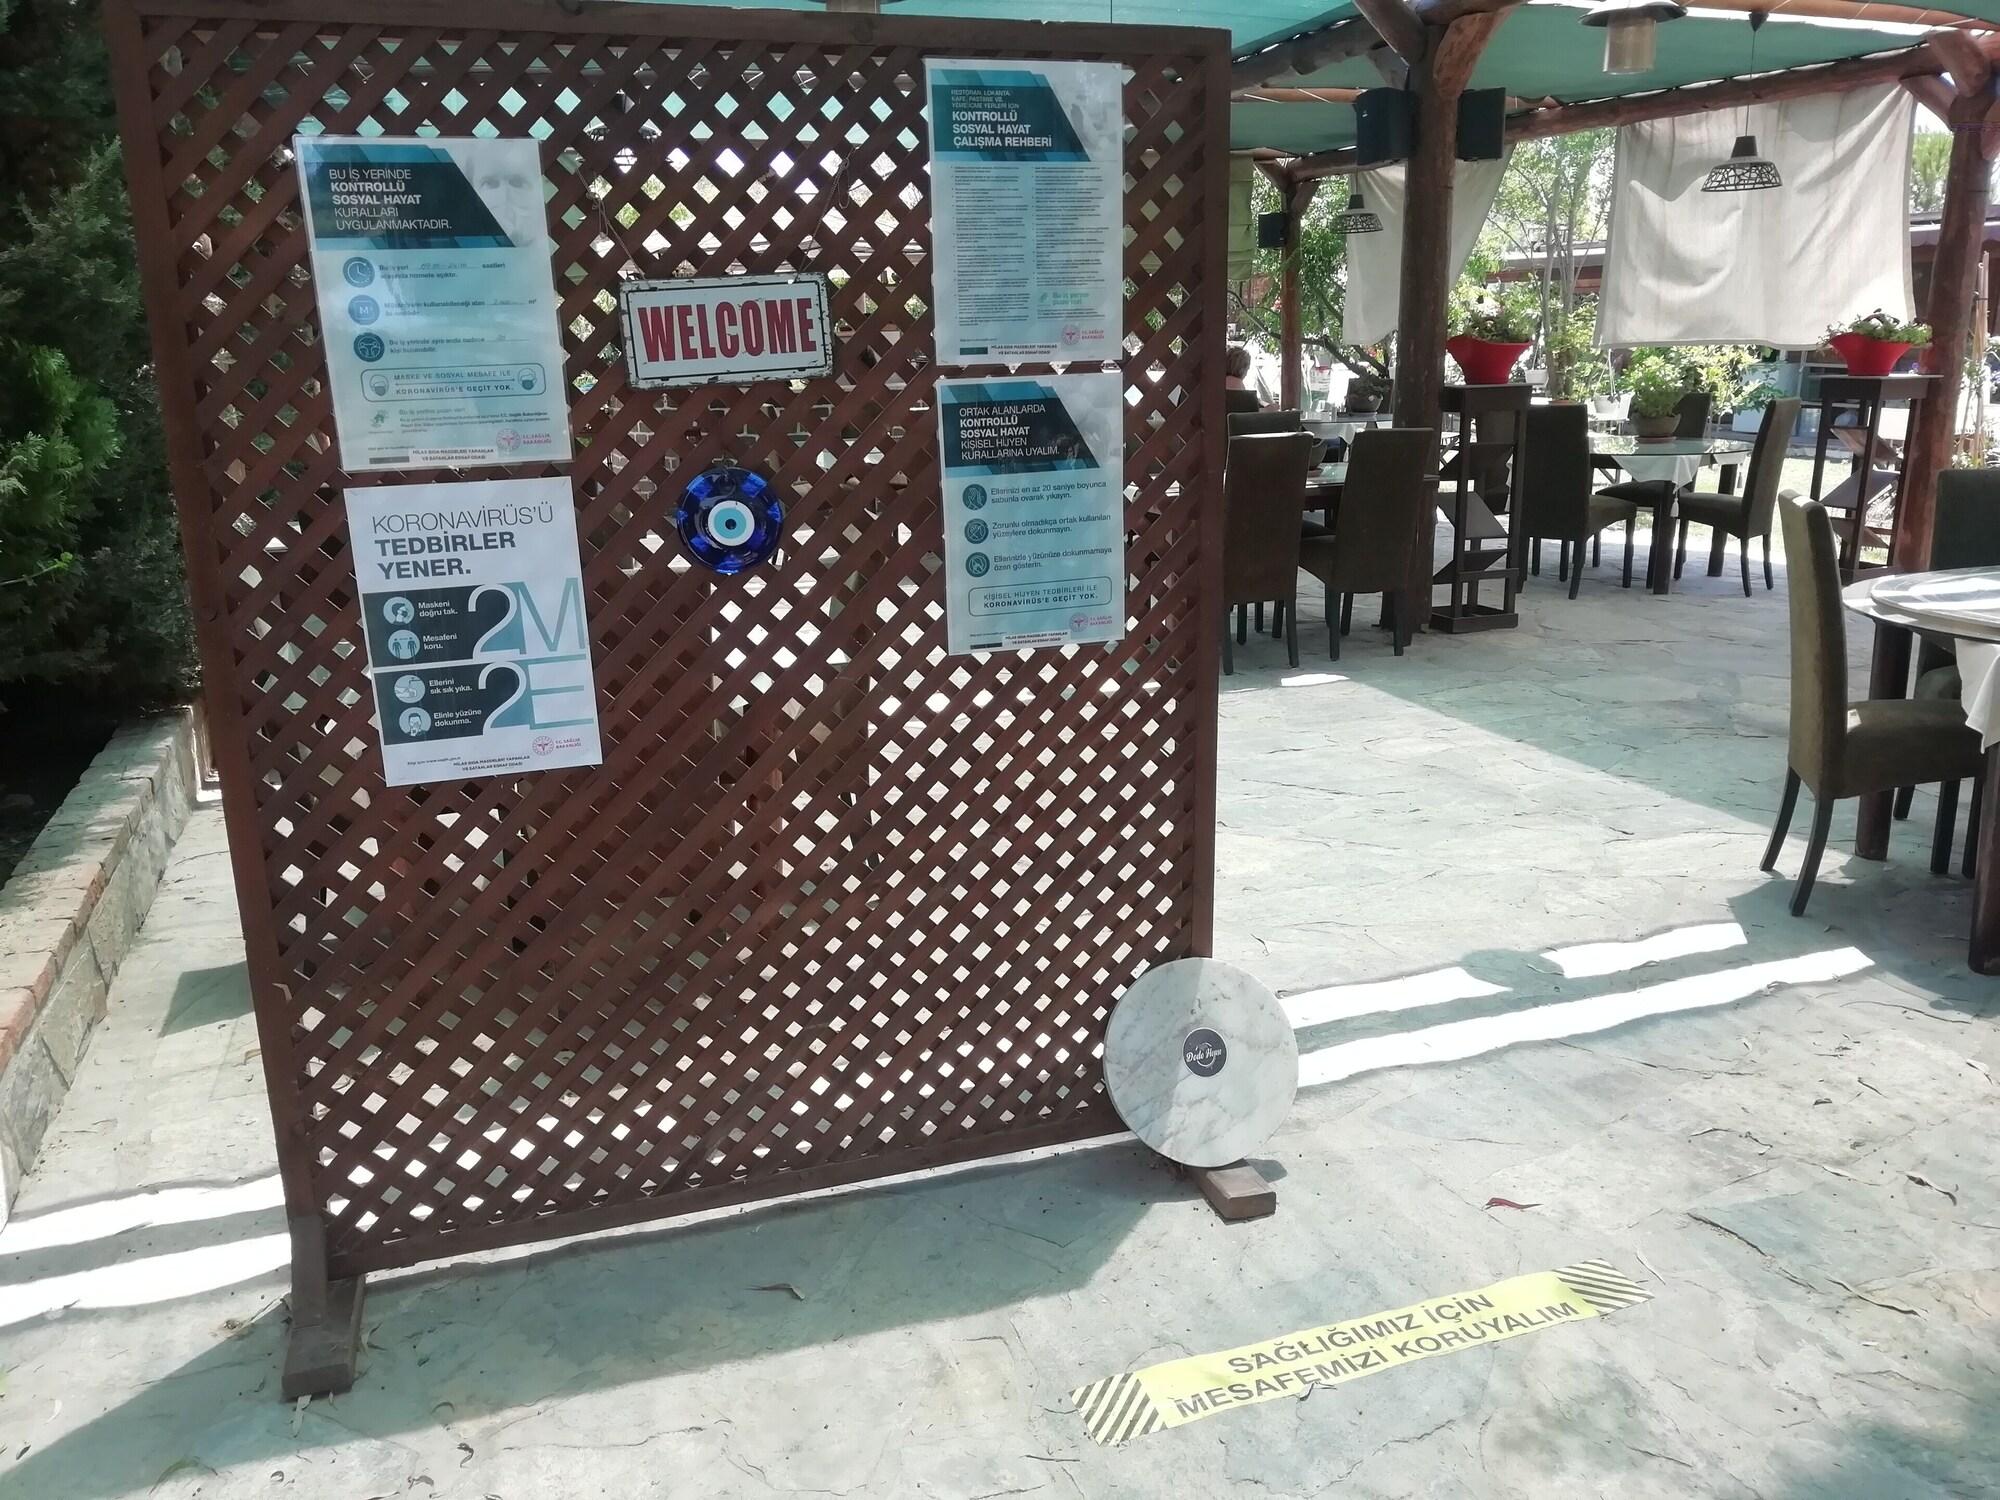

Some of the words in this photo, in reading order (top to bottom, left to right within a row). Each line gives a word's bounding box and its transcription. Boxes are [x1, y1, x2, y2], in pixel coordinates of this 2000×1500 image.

[952, 110, 1018, 121] KONTROLLÜ
[952, 124, 995, 134] SOSYAL
[997, 124, 1031, 134] HAYAT
[953, 136, 1002, 149] ÇALIŞMA
[1004, 135, 1052, 147] REHBERİ
[329, 169, 346, 180] BU
[349, 167, 360, 181] İŞ
[362, 168, 412, 180] YERİNDE
[331, 180, 405, 192] KONTROLLÜ
[332, 195, 380, 205] SOSYAL
[384, 194, 421, 205] HAYAT
[334, 207, 399, 218] KURALLARI
[336, 219, 452, 230] UYGULANMAKTADIR.
[638, 298, 816, 362] WELCOME
[435, 371, 464, 379] SOSYAL
[467, 384, 492, 393] GEÇİT
[960, 407, 990, 417] ORTAK
[992, 404, 1046, 415] ALANLARDA
[960, 415, 1018, 428] KONTROLLÜ
[960, 428, 998, 439] SOSYAL
[1000, 426, 1030, 436] HAYAT
[961, 439, 994, 450] KİŞİSEL
[996, 437, 1027, 448] HİJYEN
[961, 448, 1024, 460] KURALLARINA
[1026, 446, 1060, 456] UYALIM.
[991, 487, 1020, 495] Ellerinizi
[1053, 484, 1075, 492] saniye
[1077, 481, 1106, 489] boyunca
[991, 495, 1019, 503] sabunla
[1046, 492, 1072, 501] yıkayın.
[372, 501, 553, 534] KORONAVİRÜS'Ü
[992, 520, 1020, 529] Zorunlu
[1021, 519, 1057, 528] olmadıkça
[1058, 516, 1077, 524] ortak
[1079, 514, 1111, 523] kullanılan
[992, 529, 1026, 539] yüzeylere
[1028, 526, 1072, 535] dokunmayın.
[375, 531, 516, 556] TEDBİRLER
[993, 555, 1026, 563] Ellerinizle
[1028, 551, 1061, 561] yüzünüze
[1062, 547, 1112, 557] dokunmamaya
[377, 558, 471, 580] YENER.
[994, 562, 1011, 571] özen
[1012, 561, 1042, 570] gösterin.
[1043, 585, 1084, 595] TEDBİRLERİ
[418, 600, 450, 609] Maskeni
[983, 597, 1050, 608] KORONAVİRÜS'E
[1053, 593, 1076, 603] GEÇİT
[419, 608, 442, 618] doğru
[443, 607, 458, 615] tak.
[468, 577, 586, 661] 2M
[423, 633, 458, 642] Mesafeni
[429, 679, 455, 687] Ellerini
[430, 687, 441, 695] sık
[455, 685, 473, 694] yıka.
[479, 654, 594, 735] 2E
[434, 711, 454, 720] Elinle
[455, 709, 482, 719] yüzüne
[434, 718, 472, 727] dokunma.
[1228, 1313, 1423, 1373] SAĞLIĞIMIZ
[1421, 1294, 1495, 1323] İÇİN
[1174, 1346, 1389, 1418] MESAFEMİZİ
[1391, 1302, 1579, 1357] KORUYALIM
